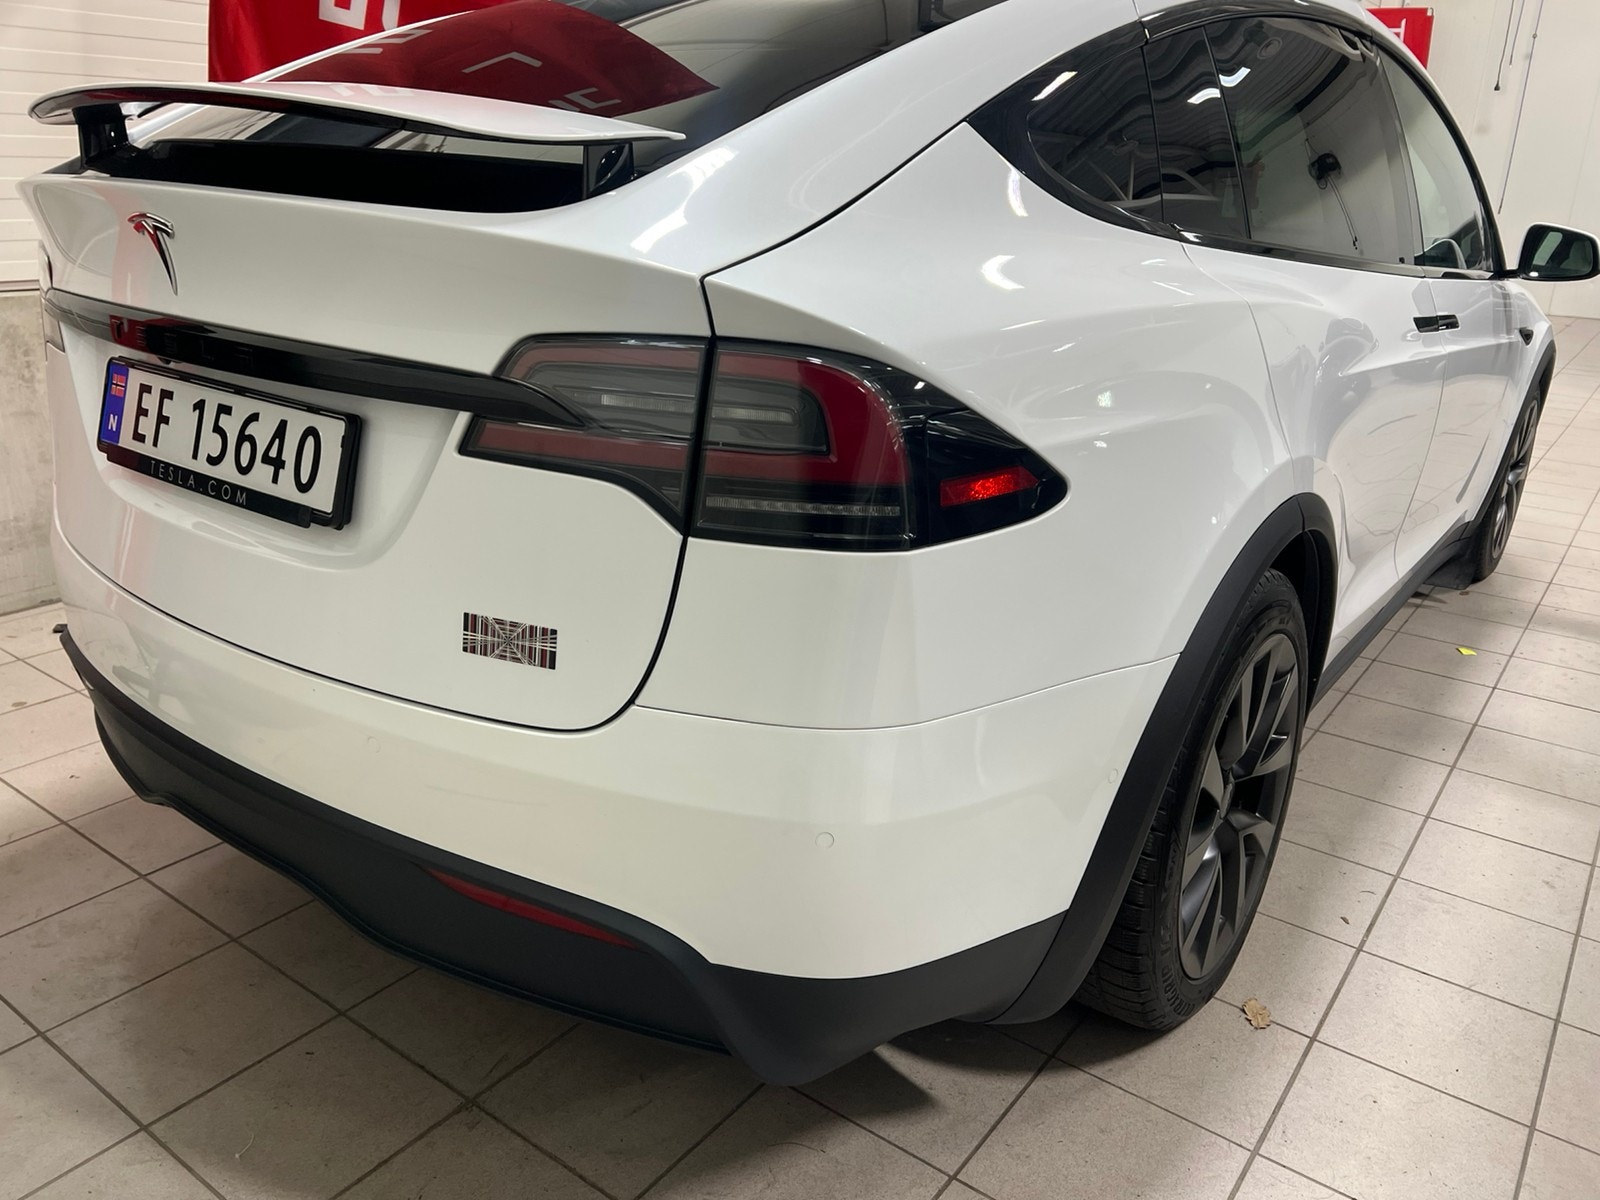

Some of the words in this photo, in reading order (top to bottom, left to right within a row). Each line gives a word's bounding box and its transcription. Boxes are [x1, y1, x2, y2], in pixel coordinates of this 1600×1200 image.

[108, 413, 118, 432] N
[132, 383, 174, 448] EF
[191, 399, 322, 494] 15640
[150, 460, 247, 506] TESLA.COM
